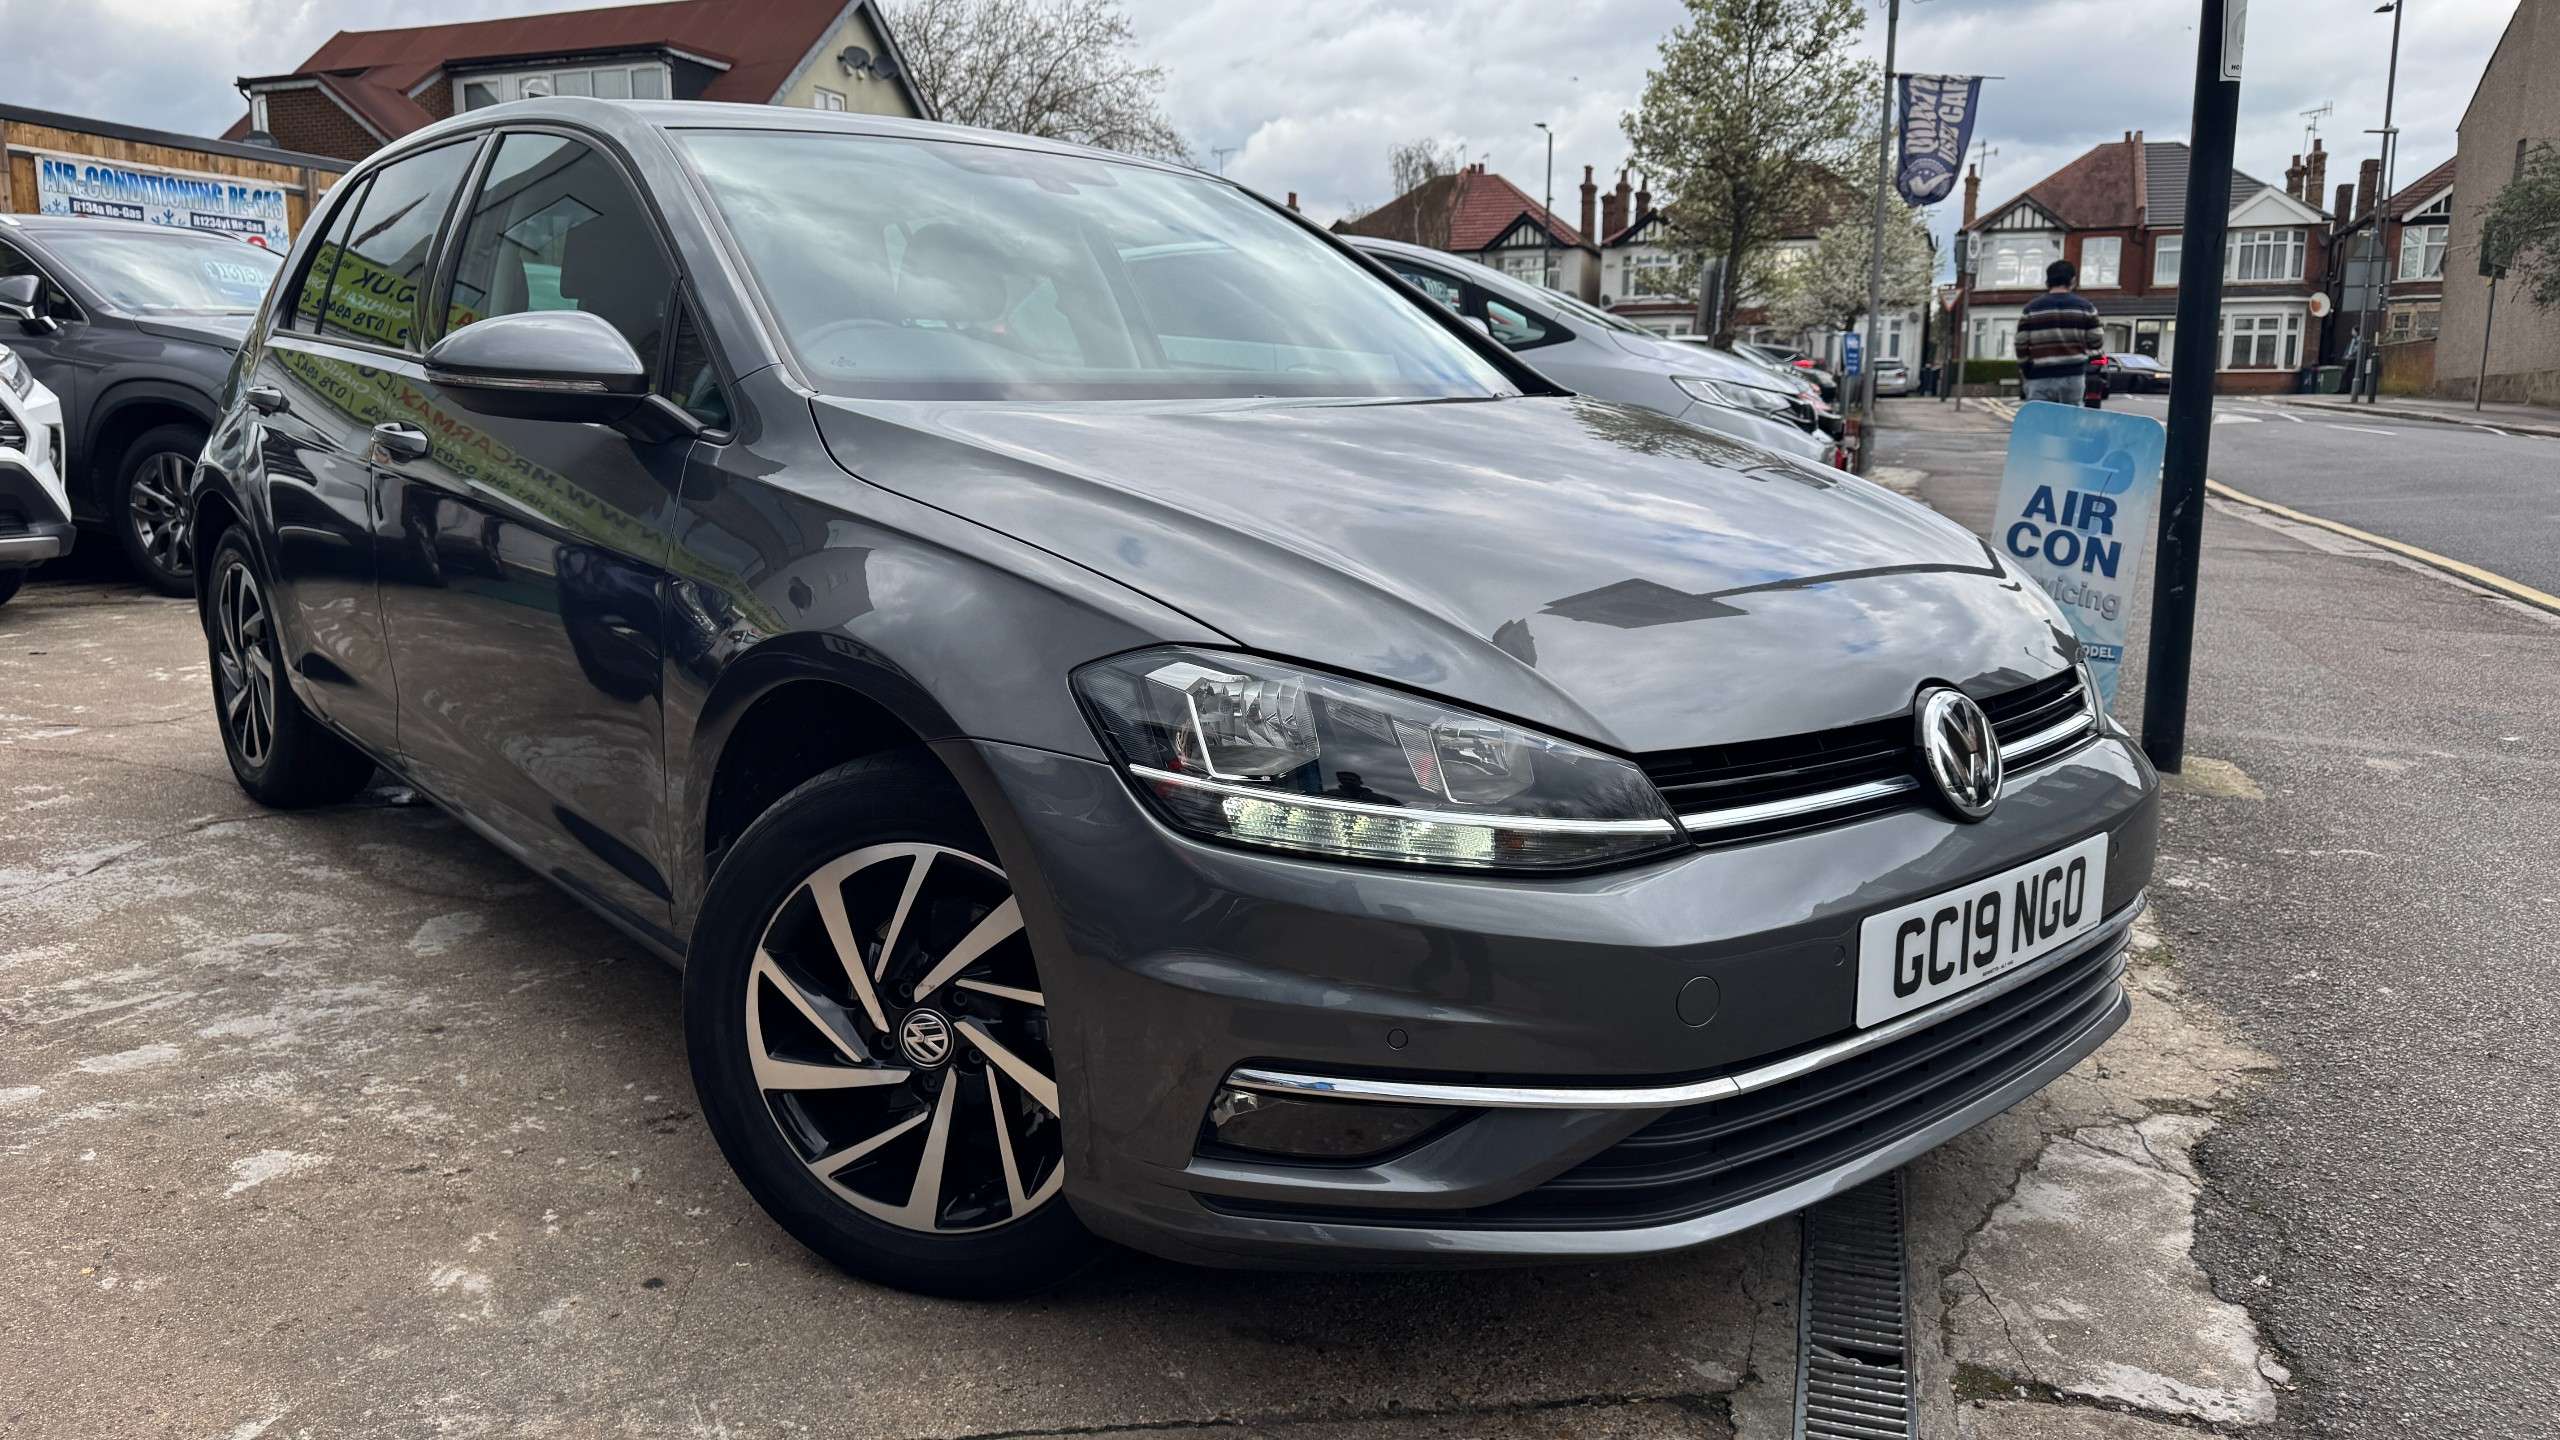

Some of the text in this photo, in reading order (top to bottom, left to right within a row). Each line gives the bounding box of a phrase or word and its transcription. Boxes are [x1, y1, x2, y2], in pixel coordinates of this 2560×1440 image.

[43, 159, 283, 219] AIR-CONDITIONING RE-GAS
[73, 200, 143, 219] R134a Re-Gas
[2022, 485, 2117, 535] AIR
[2006, 521, 2122, 579] CON
[2040, 576, 2121, 621] vicing
[2083, 644, 2117, 660] ODEL
[1894, 856, 2086, 998] GC19 NGO
